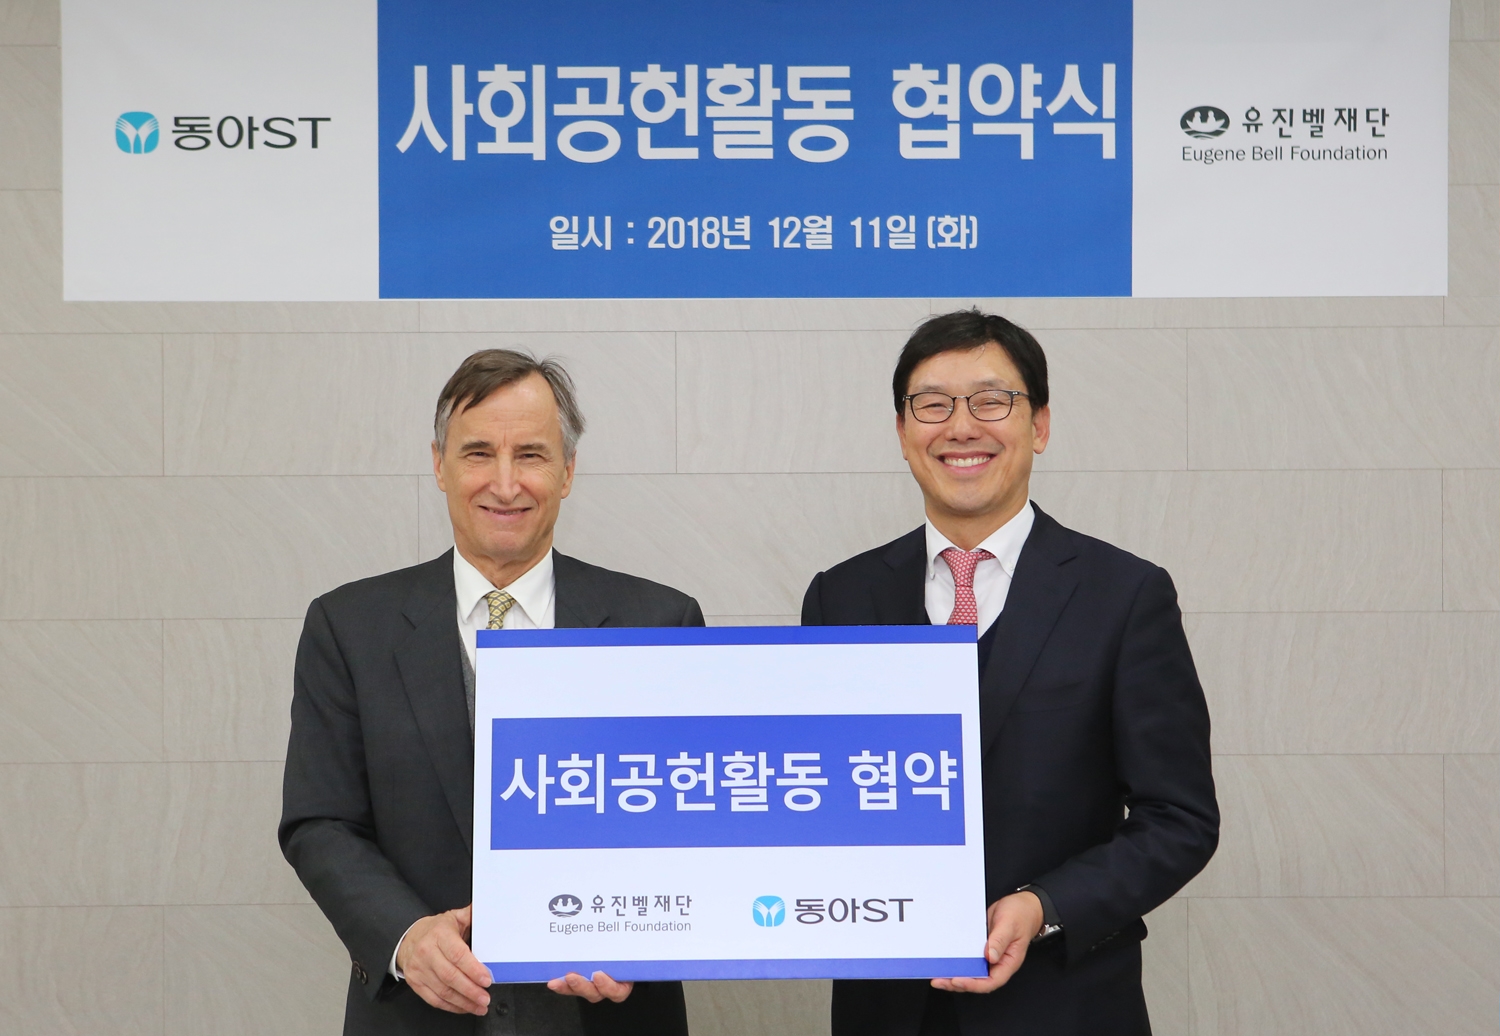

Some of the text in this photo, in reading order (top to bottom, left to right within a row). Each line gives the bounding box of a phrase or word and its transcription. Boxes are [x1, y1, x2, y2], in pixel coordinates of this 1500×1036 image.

[397, 64, 1115, 163] 사회공헌활동 협약식
[1242, 106, 1390, 139] 유진벨재단
[172, 116, 331, 151] 동아ST
[1182, 145, 1388, 165] Eugene Bell Foundation
[549, 215, 612, 251] 일시
[648, 215, 751, 251] 2018년
[768, 215, 833, 250] 12월
[500, 750, 958, 815] 사회공헌활동 협약
[591, 894, 914, 925] 유진벨재단 동아ST
[550, 920, 692, 935] Eugene Bell Foundation
